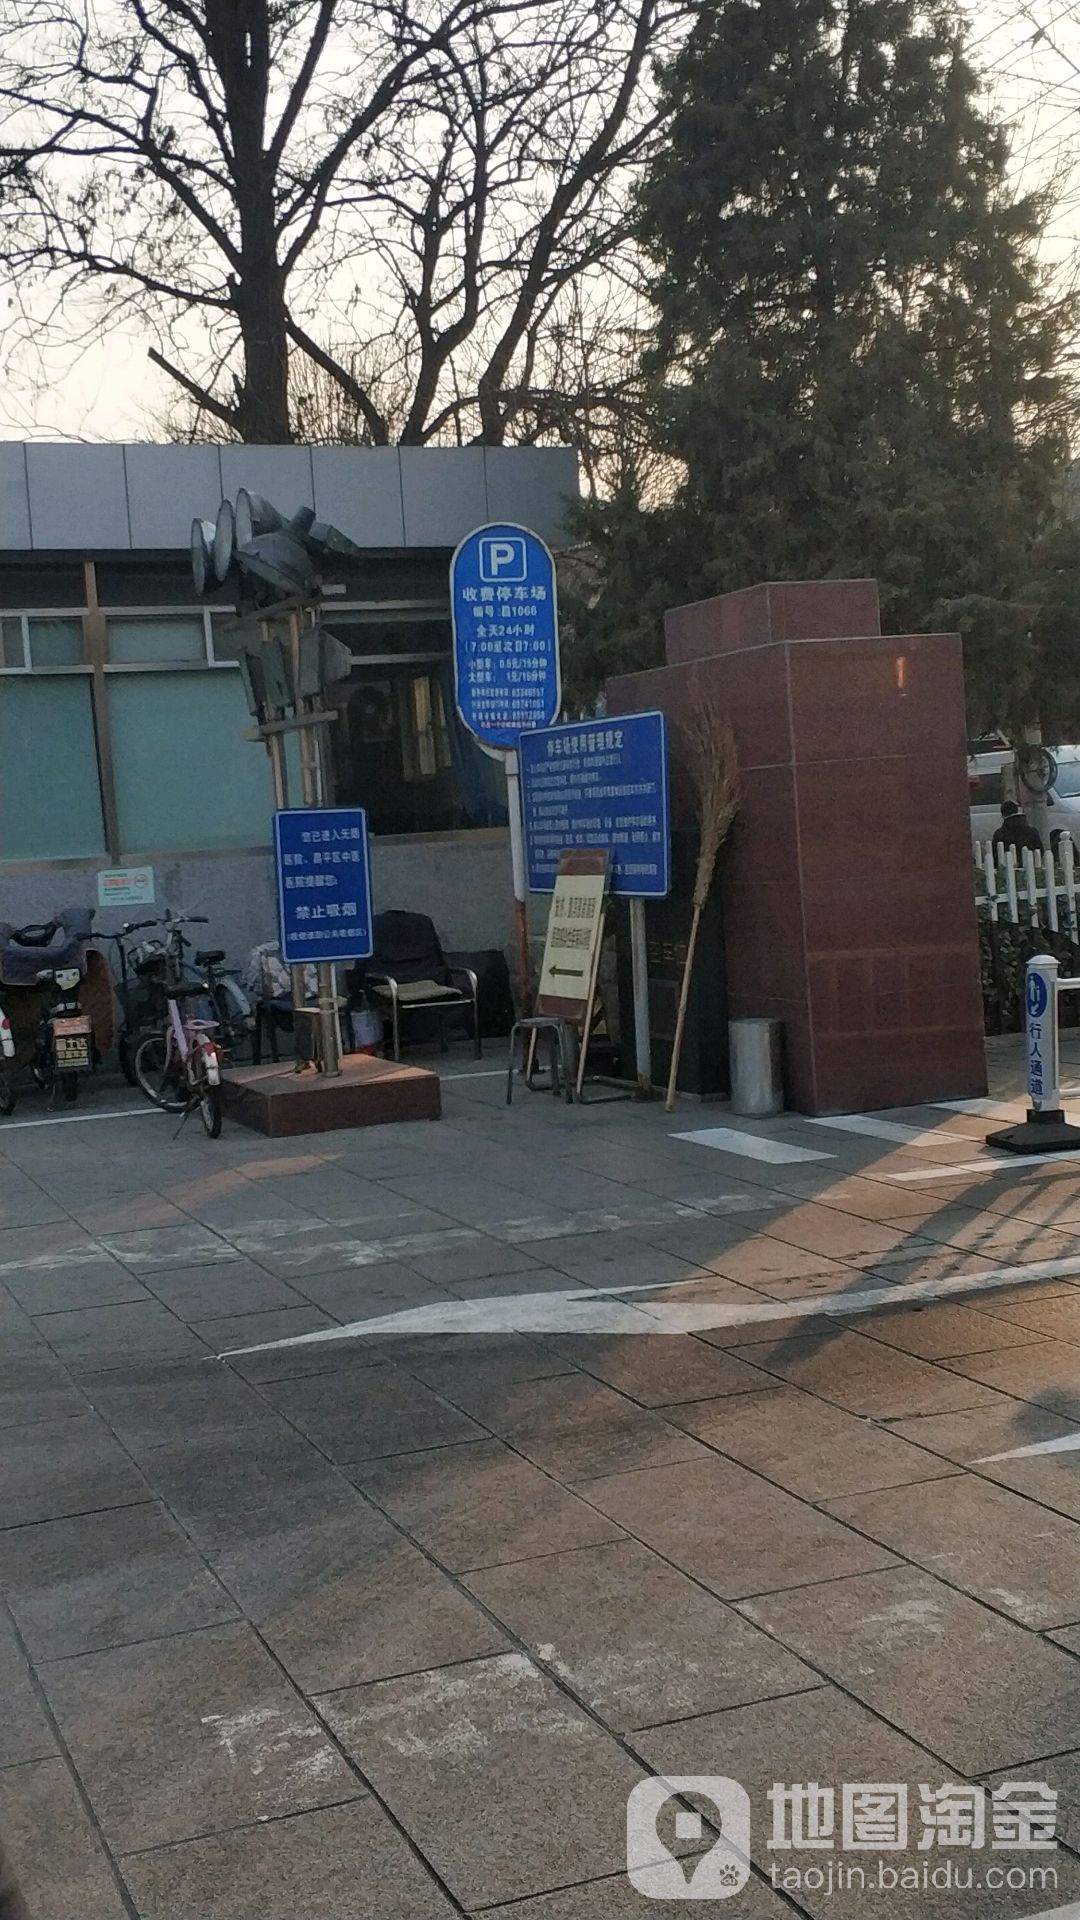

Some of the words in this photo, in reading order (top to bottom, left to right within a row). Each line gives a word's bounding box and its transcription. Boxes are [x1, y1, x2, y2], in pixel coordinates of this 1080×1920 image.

[490, 543, 515, 576] P
[462, 585, 546, 602] 收费停车场
[476, 623, 535, 638] 全天24小时
[301, 827, 360, 843] 您已进入无烟
[294, 901, 357, 920] 禁止吸烟
[1029, 1023, 1044, 1095] 行人通道
